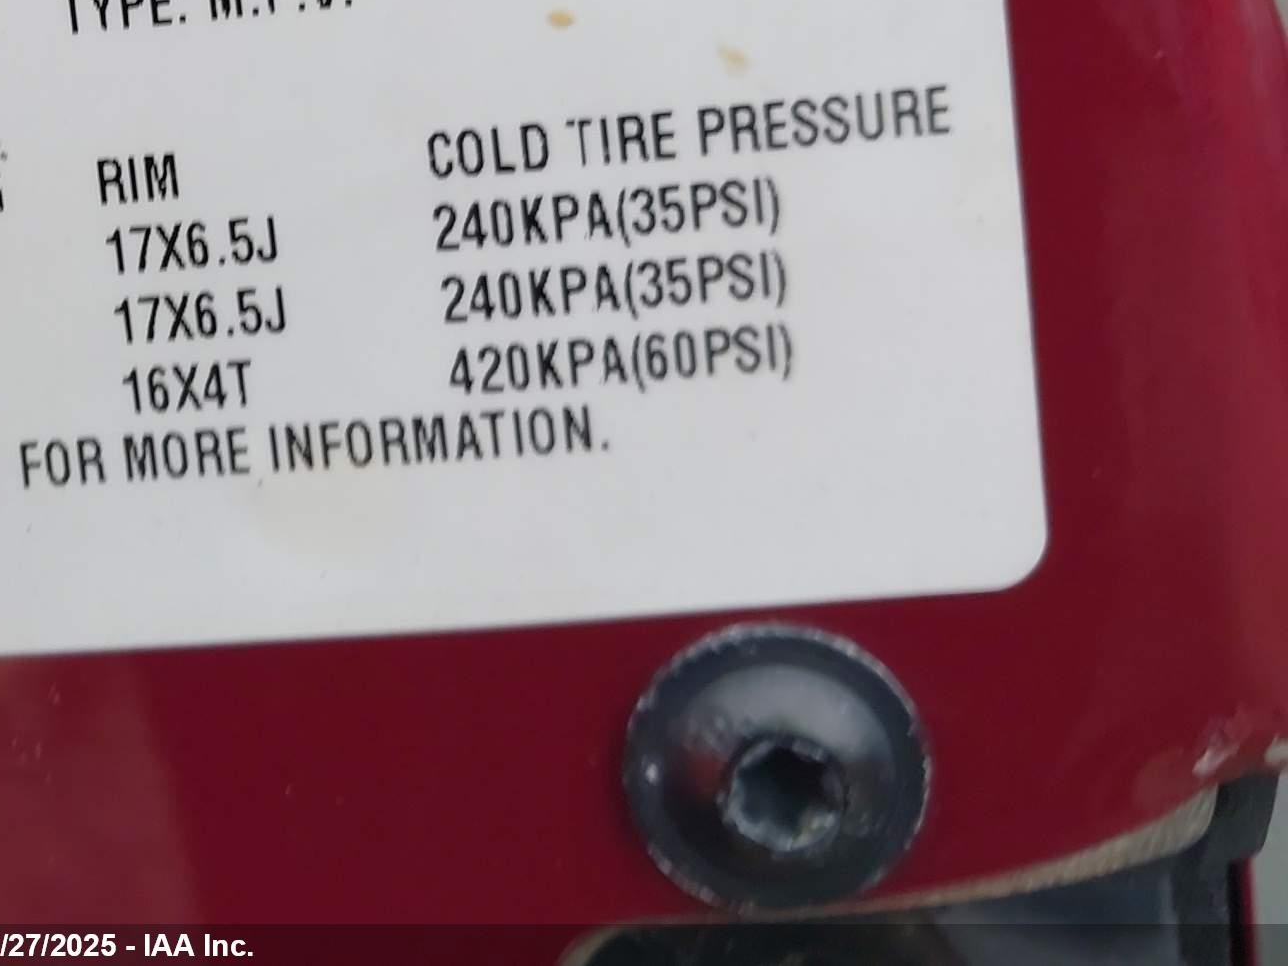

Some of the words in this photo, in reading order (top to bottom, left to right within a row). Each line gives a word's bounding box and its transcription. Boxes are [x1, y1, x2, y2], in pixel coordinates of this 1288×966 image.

[427, 122, 550, 180] COLD
[565, 110, 677, 167] TIRE
[697, 85, 950, 157] PRESSURE
[96, 152, 180, 206] RIM
[432, 177, 780, 252] 240KPA(35PSI)
[105, 215, 278, 275] 17X6.5J
[113, 285, 287, 345] 17X6.5J
[440, 251, 787, 324] 240KPA(35PSI)
[122, 359, 252, 415] 16X4T
[449, 324, 793, 395] 420KPA(60PSI)
[19, 437, 107, 489] FOR
[122, 426, 250, 482] MORE
[268, 404, 609, 473] INFORMATION.
